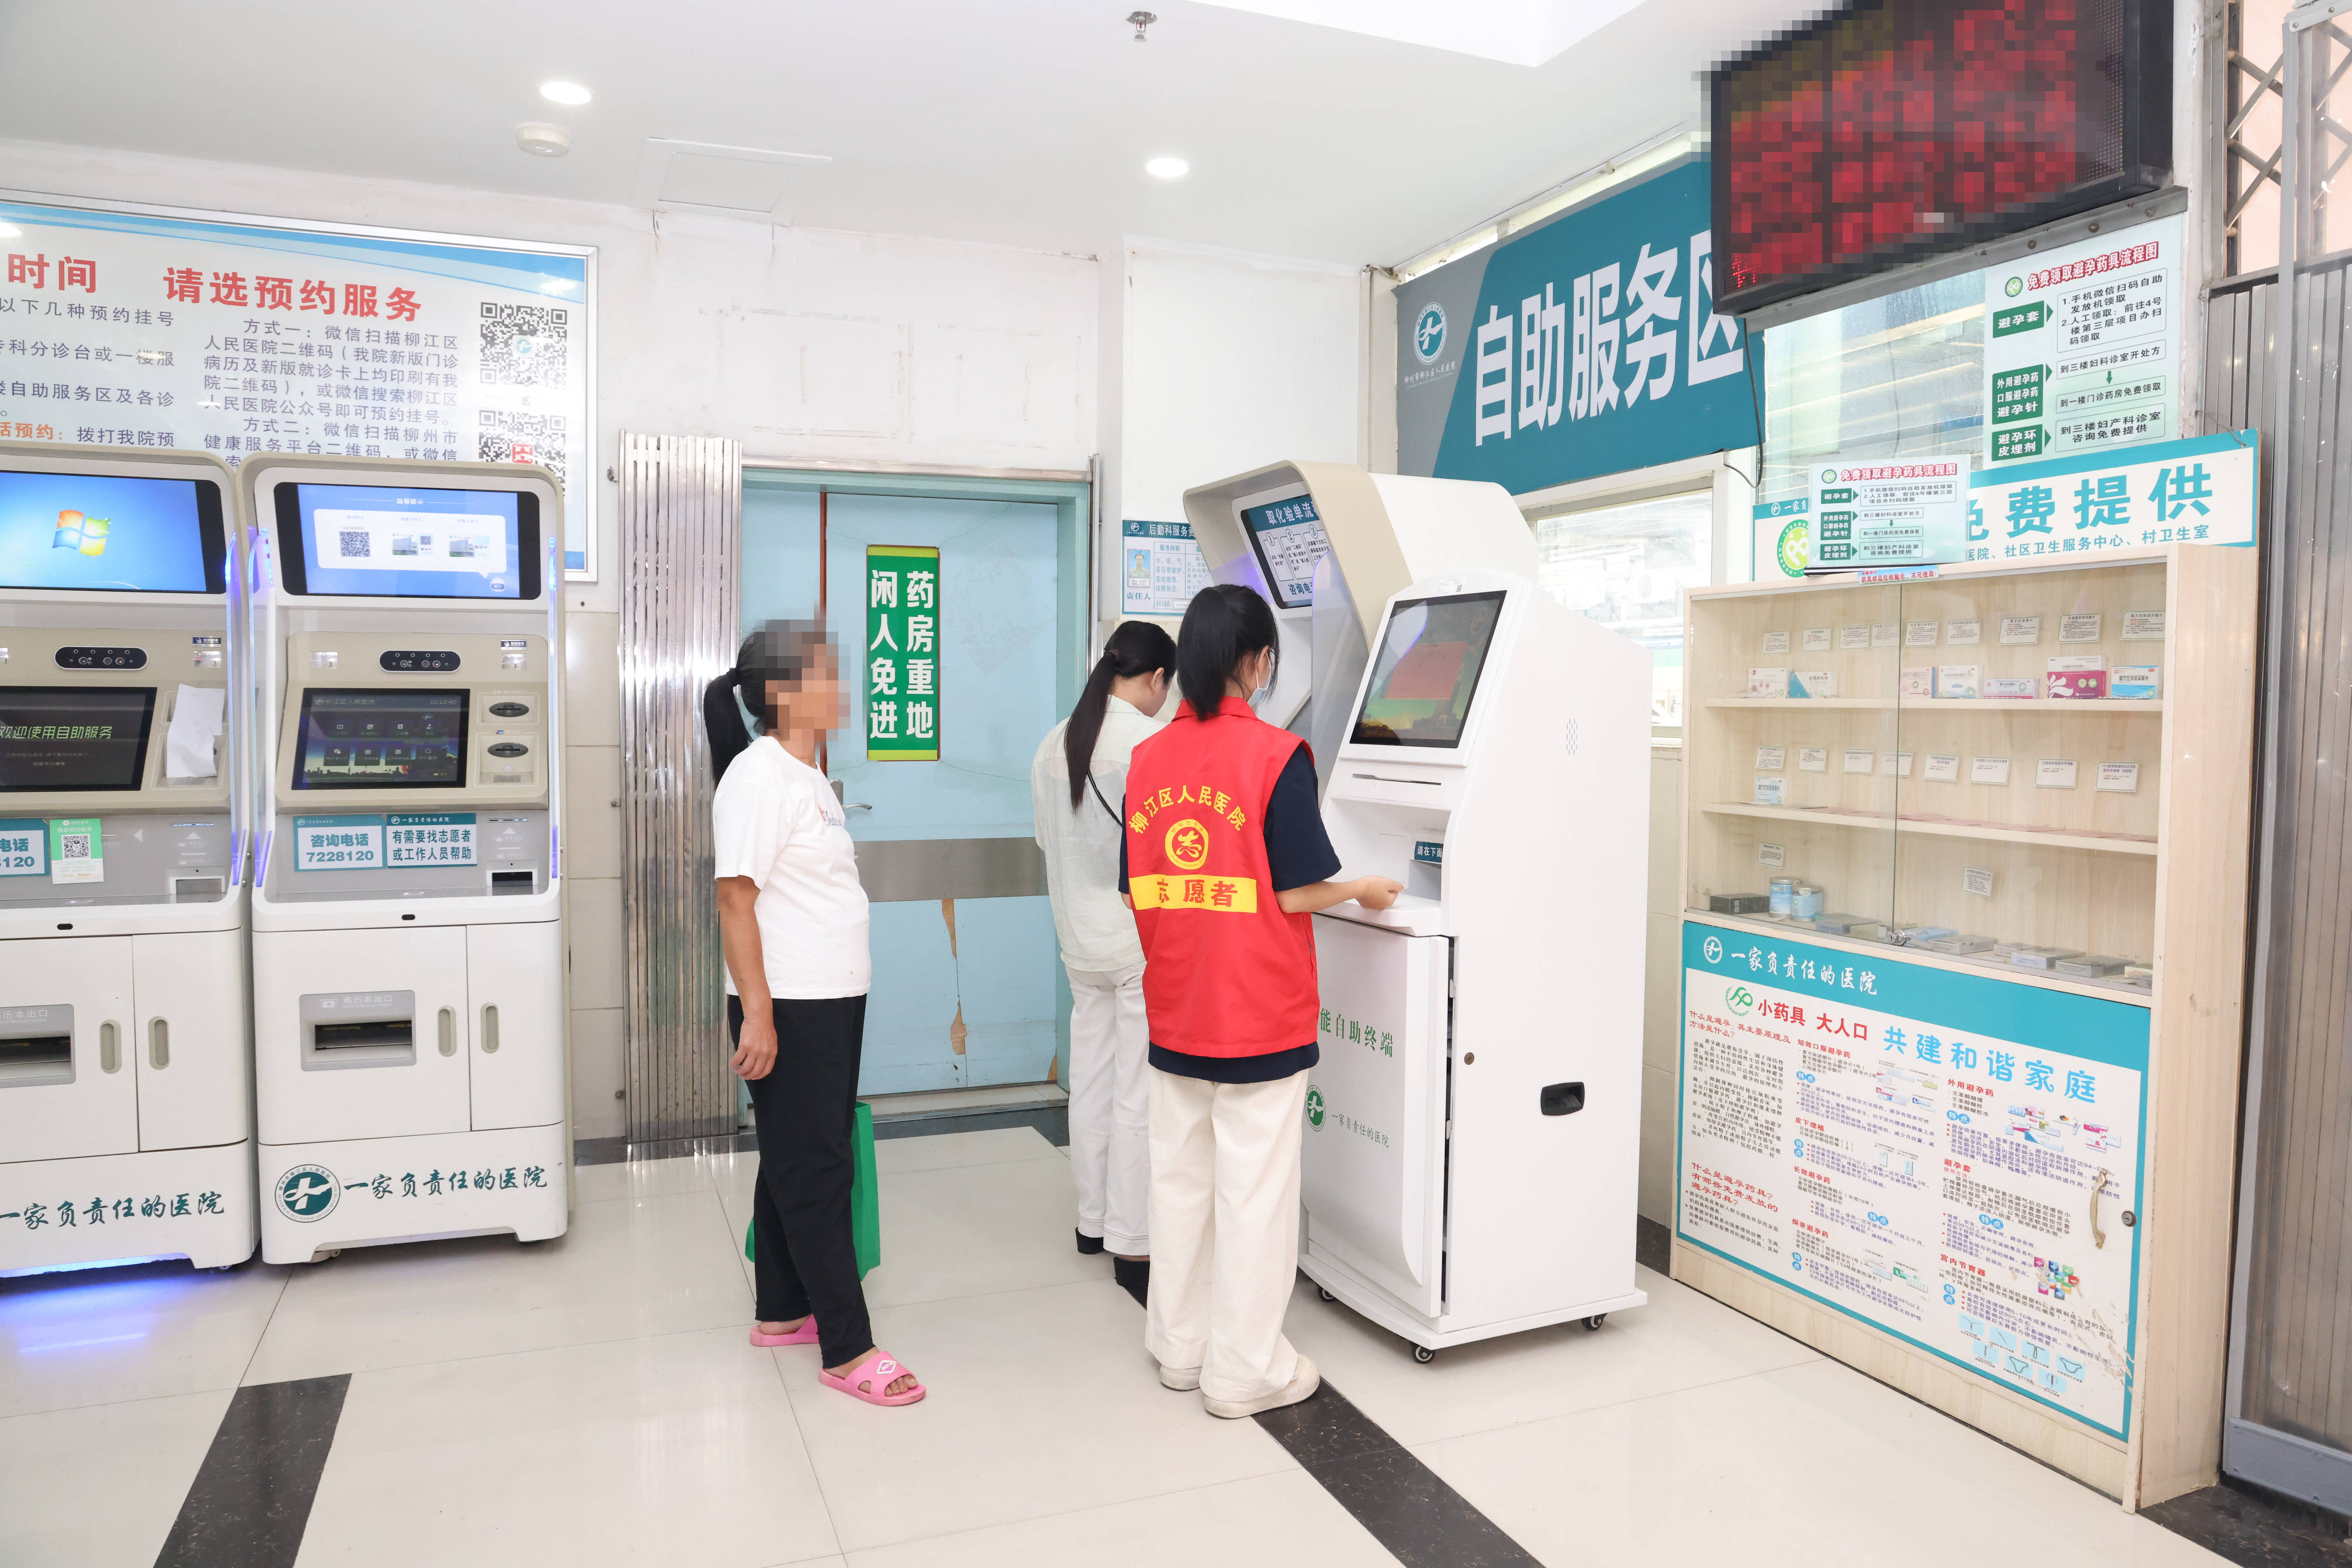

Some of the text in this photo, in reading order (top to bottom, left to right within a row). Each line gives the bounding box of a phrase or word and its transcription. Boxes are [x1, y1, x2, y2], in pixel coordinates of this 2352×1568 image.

[8, 254, 96, 293] 时间
[2028, 241, 2159, 290] 免费领取避孕药具流程图
[163, 267, 422, 322] 请选预约服务
[2062, 274, 2162, 305] 1.手机微信扫码自助
[0, 298, 174, 326] 以下几种预约挂号
[2071, 294, 2126, 314] 发放机领取
[1998, 311, 2039, 328] 避孕套
[2071, 308, 2161, 335] 楼第三层项目办扫
[1476, 230, 1743, 447] 自助服务区
[2070, 333, 2100, 345] 码领取
[0, 340, 174, 366] 科分诊台或一楼服
[2060, 346, 2160, 373] 到三楼妇科诊室开处方
[204, 356, 458, 388] 病历及新版就诊卡上均印刷有我
[1404, 360, 1456, 383] 柳州市柳江区人民医院
[1997, 371, 2039, 388] 外用避孕药
[1997, 387, 2039, 403] 口服避孕药
[2060, 382, 2161, 407] 到一楼门诊药房免费领取
[1997, 401, 2038, 418] 避孕针
[2061, 411, 2161, 435] 到三楼妇产科诊室
[1998, 429, 2037, 444] 避孕环
[2073, 424, 2147, 443] 咨询免费提供
[1998, 443, 2036, 457] 皮埋剂
[1841, 463, 1957, 481] 免费领取避孕药具流程图
[1864, 484, 1952, 493] 1.手机微信扫码自助发放机领取
[1265, 501, 1319, 525] 取化验单流
[870, 570, 898, 738] 闲人免进
[906, 571, 934, 738] 药房重地
[0, 726, 112, 739] 欢迎使用自助服务
[1129, 785, 1246, 833] 柳江区人民医院
[311, 833, 369, 847] 咨询电话
[392, 829, 471, 844] 有需要找志愿者
[0, 856, 34, 867] 120
[307, 851, 374, 862] 7228120
[393, 846, 471, 861] 或工作人员帮助
[1417, 846, 1442, 858] 请在下面
[1157, 878, 1238, 907] 志愿者
[1731, 946, 1877, 995] 一家负责任的医院
[343, 995, 392, 1004] 病历本出口
[1758, 999, 1867, 1041] 小药具 大人口
[1320, 1008, 1393, 1058] 能自助终端
[1798, 1039, 1851, 1059] 短效口服避孕药
[1883, 1026, 2096, 1104] 共建和谐家庭
[1797, 1072, 1815, 1082] 特点
[1948, 1079, 1994, 1097] 外用避孕药
[1795, 1117, 1824, 1131] 皮下埋植
[1948, 1111, 1969, 1123] 特点
[1332, 1114, 1389, 1148] 一家负责任的医院
[1794, 1166, 1830, 1184] 长效避孕药
[1944, 1158, 1971, 1173] 避孕套
[343, 1165, 548, 1199] 一家负责任的医院
[1692, 1163, 1773, 1199] 什么是避孕药具？
[1692, 1173, 1778, 1212] 有哪些免费发放的
[1692, 1182, 1738, 1206] 避孕药具？
[0, 1191, 224, 1229] 一家负责任的医院
[1868, 1212, 1888, 1225] 特点
[1792, 1219, 1829, 1238] 探亲避孕药
[1980, 1215, 2003, 1229] 特点
[1793, 1253, 1801, 1270] 特点
[1941, 1254, 1986, 1277] 宫内节育器
[1945, 1285, 1954, 1304] 特点
